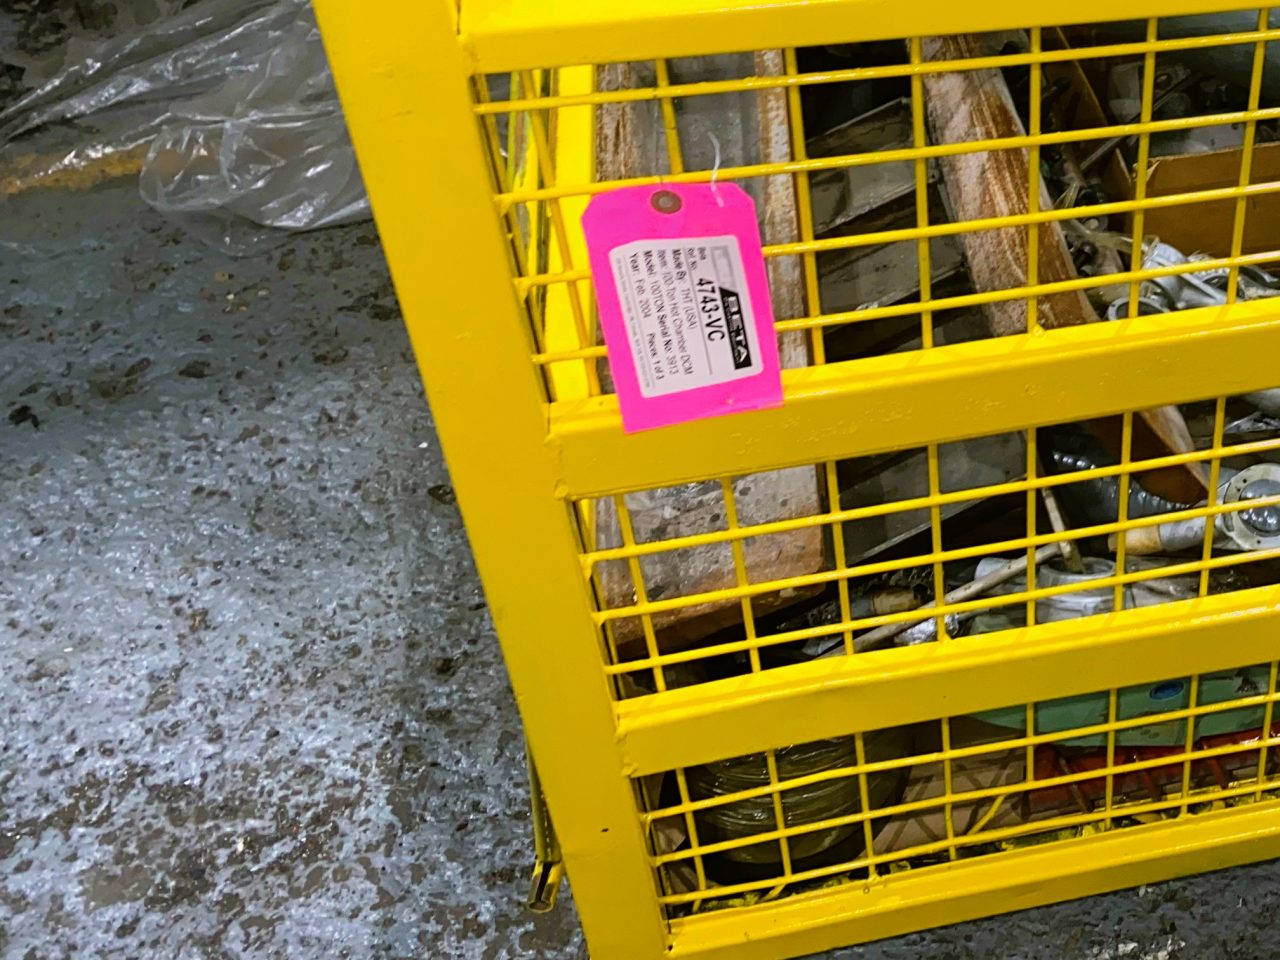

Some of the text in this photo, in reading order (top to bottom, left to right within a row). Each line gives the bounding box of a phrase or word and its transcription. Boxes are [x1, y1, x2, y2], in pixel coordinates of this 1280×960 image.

[638, 298, 651, 318] 2004
[680, 288, 692, 303] THT
[668, 302, 680, 317] Hot
[683, 305, 698, 330] (USA)
[694, 276, 726, 342] 4743-VC
[648, 280, 664, 312] 100TON
[656, 314, 670, 338] Serial
[666, 355, 679, 374] 3913
[671, 318, 688, 353] Chamber
[727, 296, 749, 361] BETA
[679, 354, 693, 375] DCM
